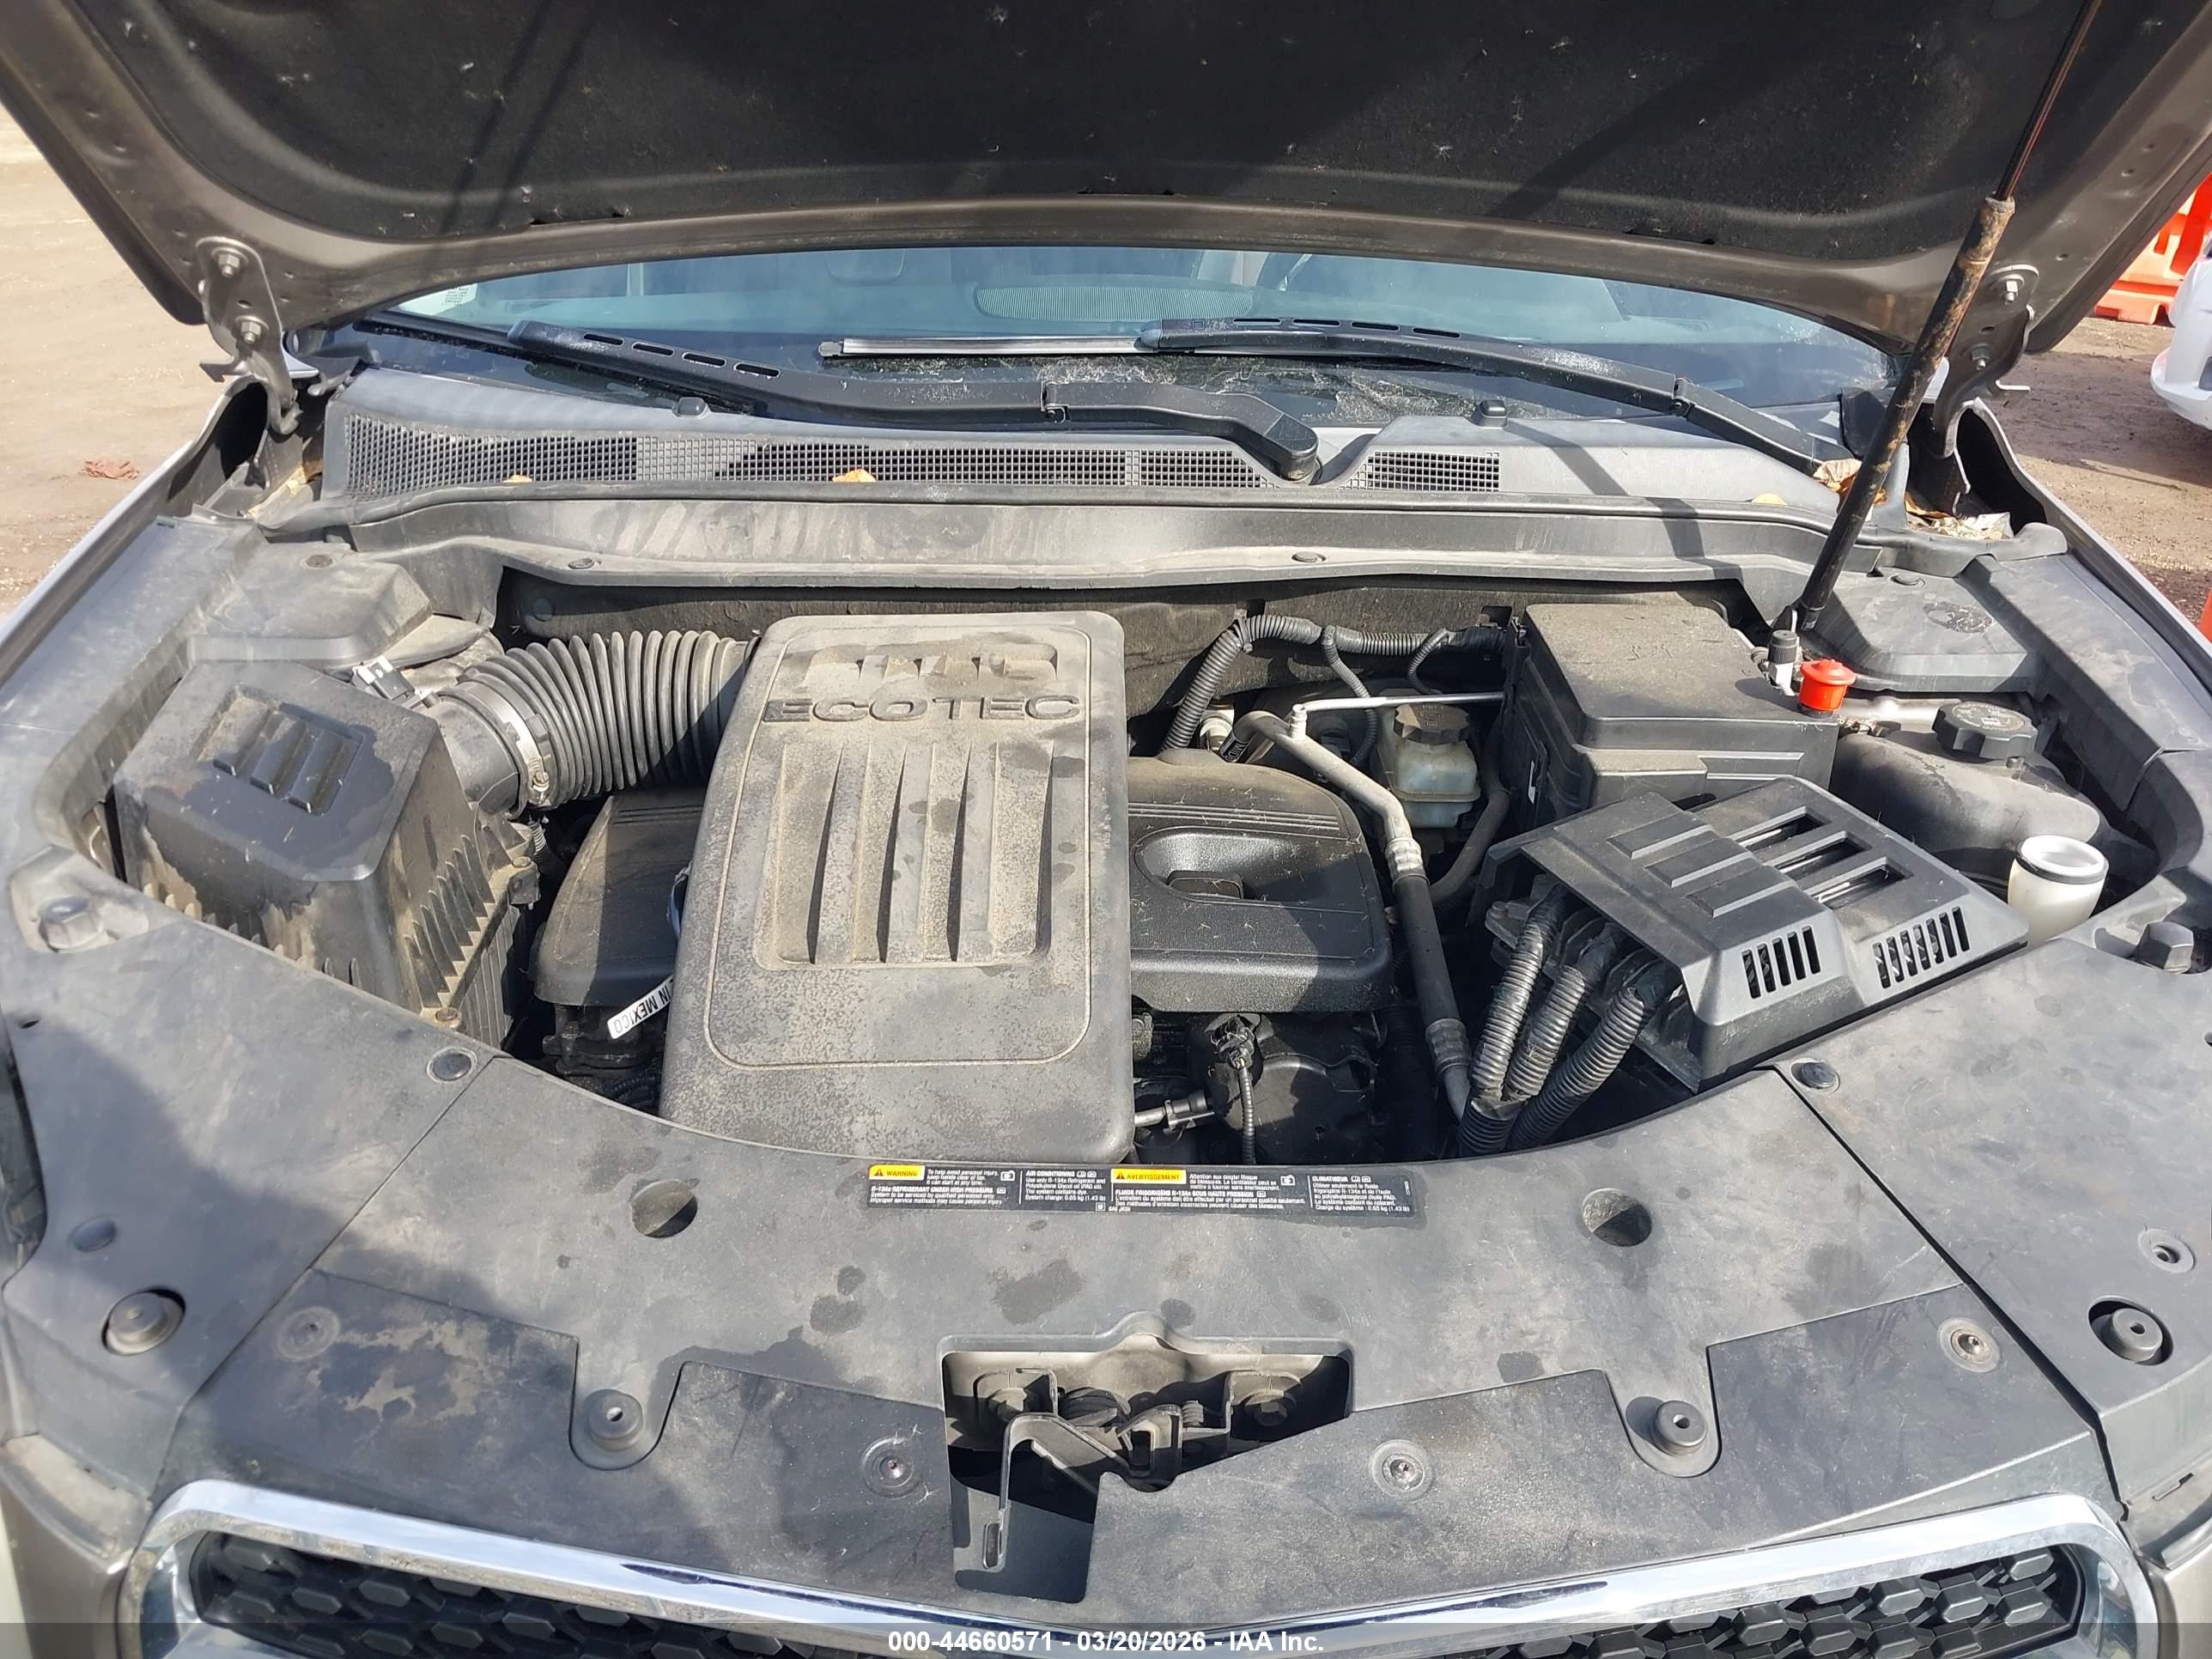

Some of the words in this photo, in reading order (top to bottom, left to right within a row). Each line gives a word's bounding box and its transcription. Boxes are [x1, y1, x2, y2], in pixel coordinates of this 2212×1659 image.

[762, 695, 1080, 722] ECOTEC
[658, 985, 671, 1005] IN
[614, 995, 659, 1033] MEXICO
